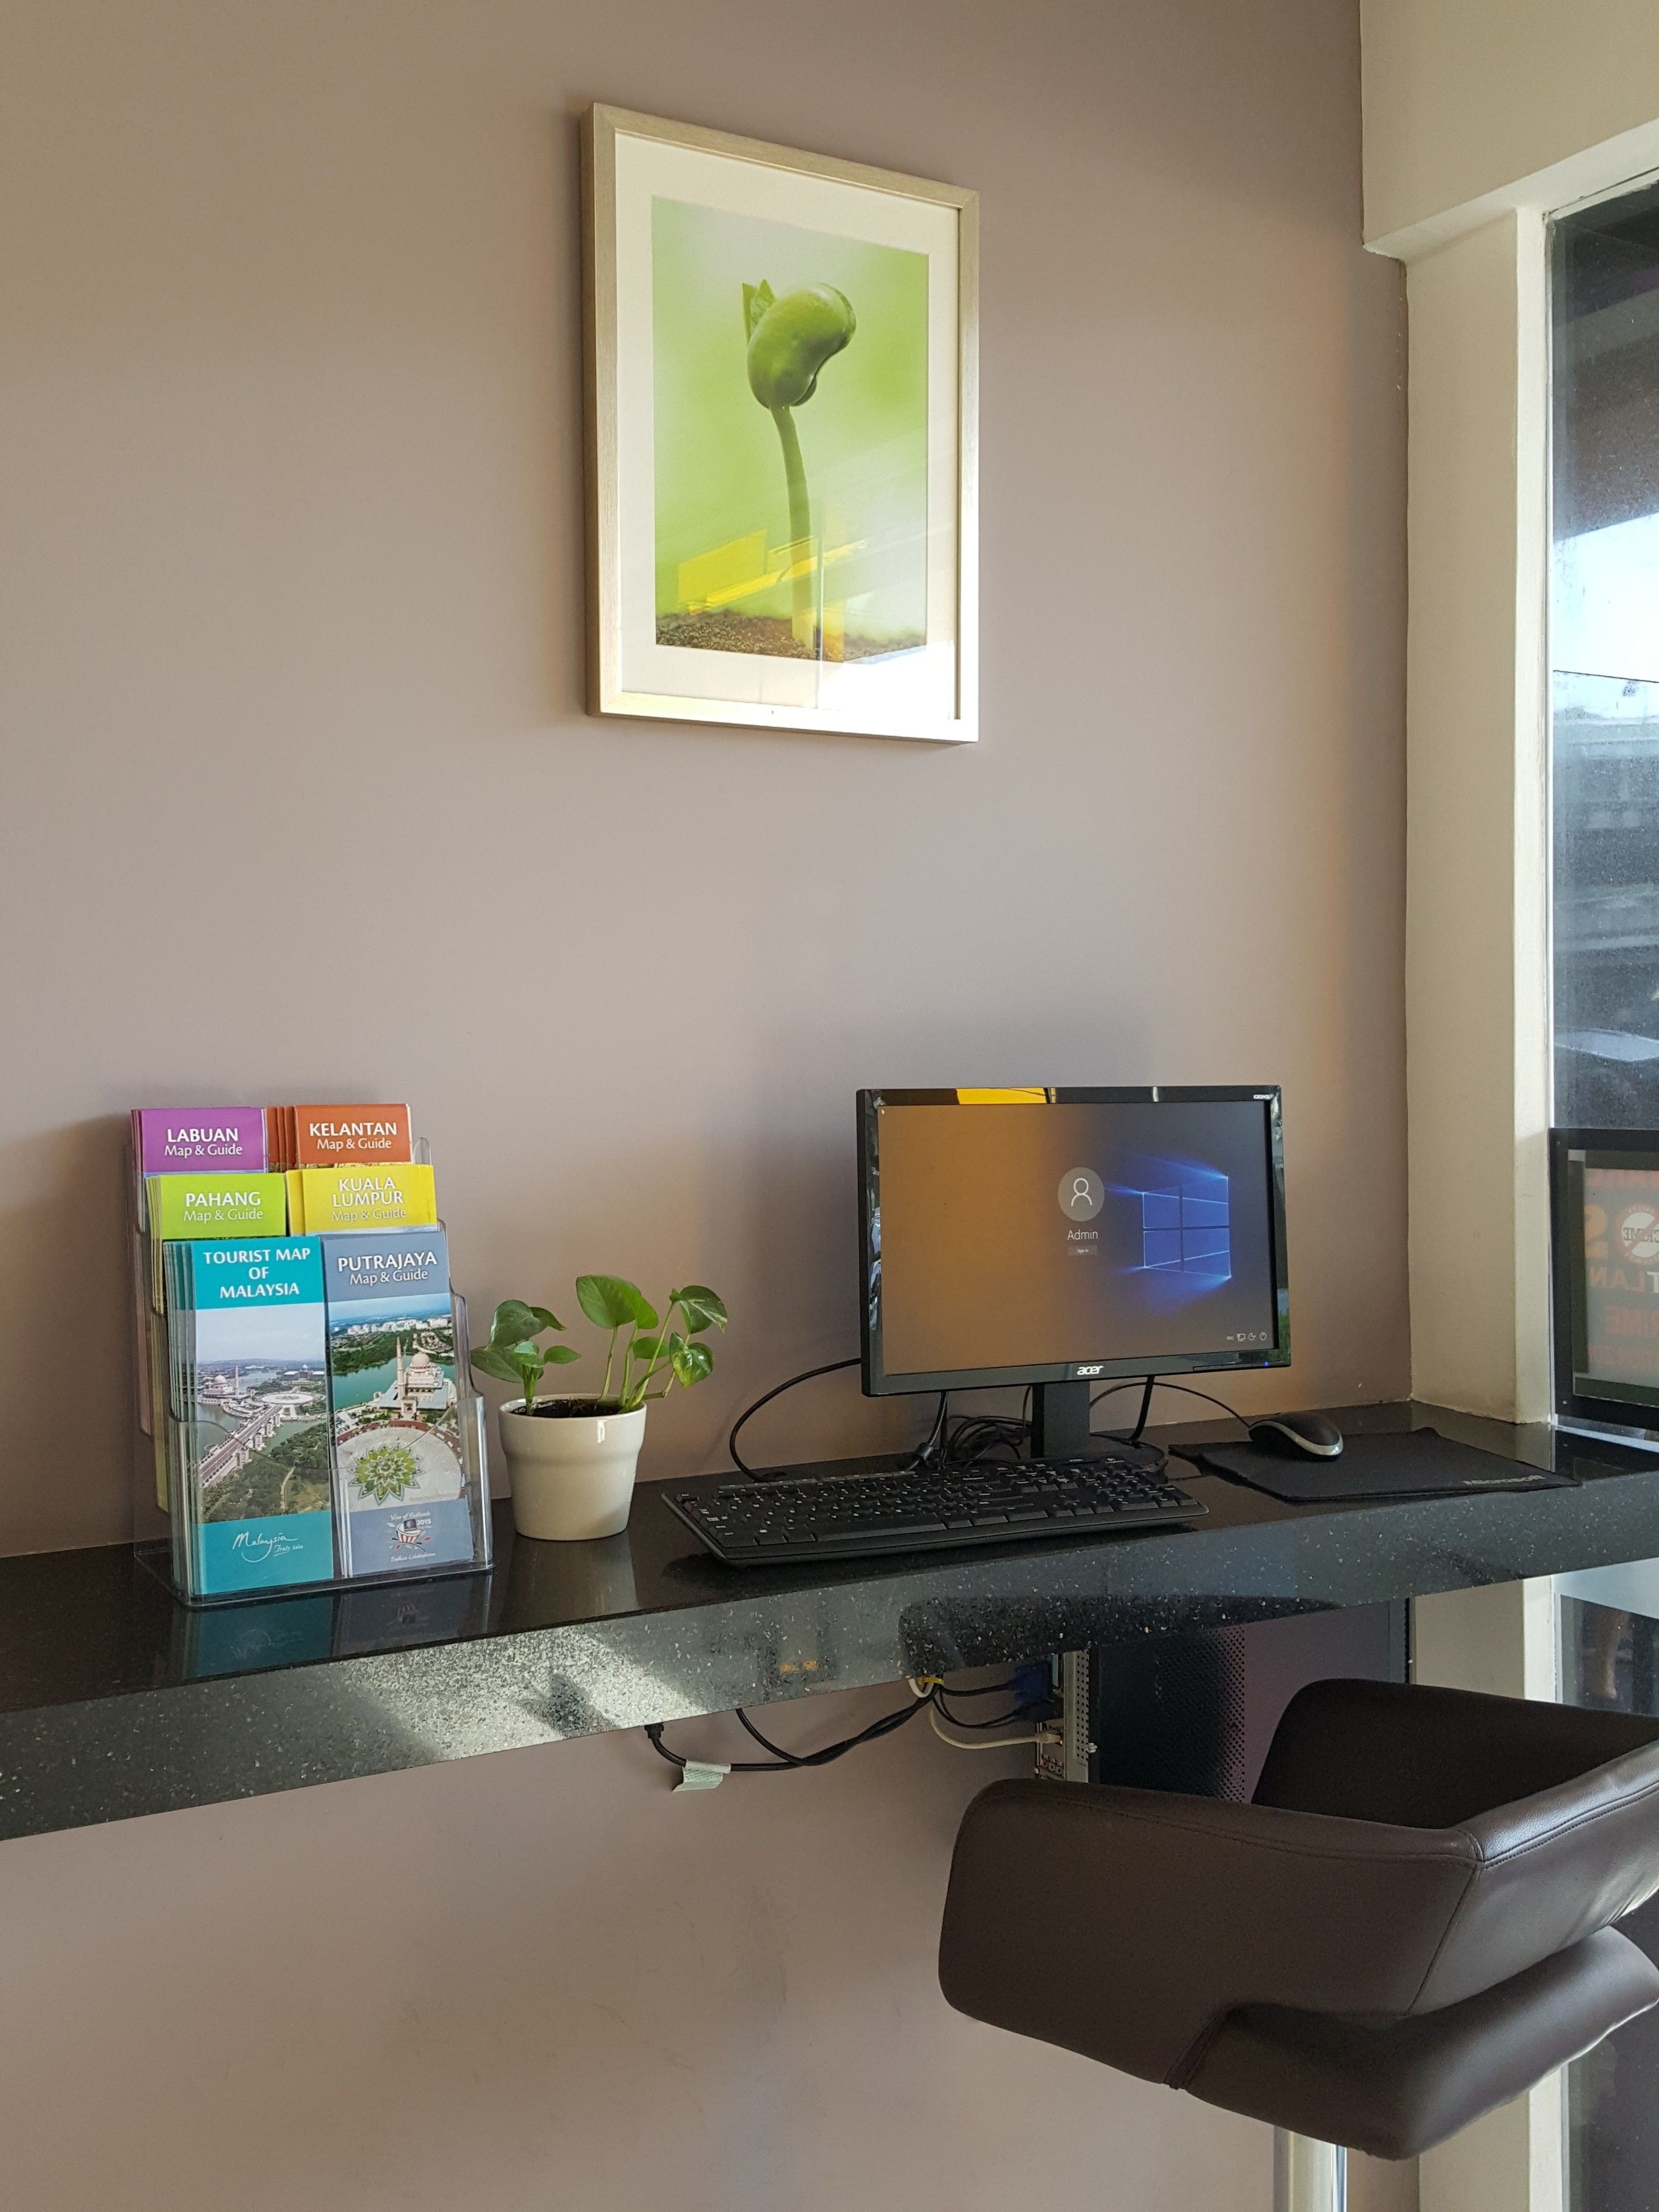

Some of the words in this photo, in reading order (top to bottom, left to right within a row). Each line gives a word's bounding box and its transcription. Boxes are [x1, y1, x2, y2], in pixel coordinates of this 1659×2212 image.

[167, 1127, 239, 1143] LABUAN
[309, 1122, 397, 1137] KELANTAN
[164, 1144, 193, 1158] Map
[195, 1144, 205, 1156] &
[206, 1142, 243, 1156] Guide
[316, 1138, 344, 1151] Map
[346, 1138, 355, 1149] &
[358, 1137, 392, 1150] Guide
[339, 1176, 396, 1192] KUALA
[185, 1191, 262, 1208] PAHANG
[332, 1190, 404, 1207] LUMPUR
[183, 1210, 212, 1224] Map
[214, 1209, 225, 1221] &
[227, 1208, 264, 1221] Guide
[332, 1209, 359, 1224] Map
[361, 1209, 369, 1221] &
[372, 1207, 407, 1219] Guide
[1067, 1229, 1099, 1240] Admin
[204, 1249, 271, 1264] TOURIST
[275, 1248, 311, 1261] MAP
[338, 1251, 438, 1273] PUTRAJAYA
[248, 1266, 268, 1280] OF
[349, 1272, 378, 1287] Map
[380, 1271, 391, 1283] &
[392, 1267, 429, 1282] Guide
[219, 1282, 300, 1300] MALAYSIA
[1077, 1365, 1104, 1376] acer
[232, 1531, 298, 1563] Malaysia
